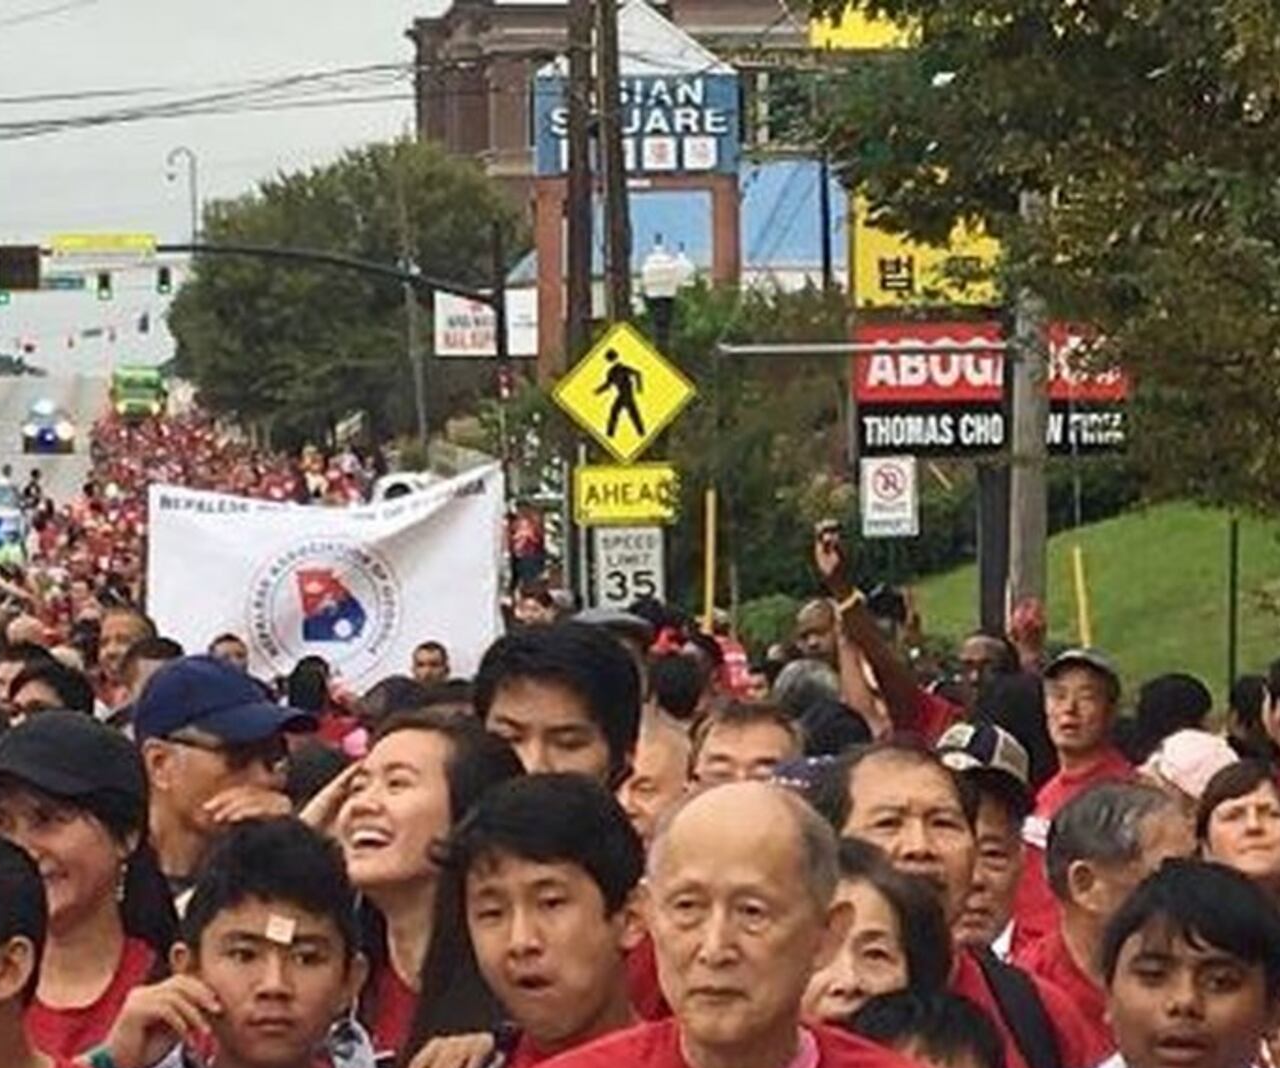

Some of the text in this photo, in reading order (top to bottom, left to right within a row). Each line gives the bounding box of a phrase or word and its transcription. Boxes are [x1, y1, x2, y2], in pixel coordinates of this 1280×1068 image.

[550, 108, 729, 135] SUARE
[862, 414, 955, 446] THOMAS
[959, 412, 1004, 445] CHO
[584, 481, 672, 508] AHEAD
[604, 569, 657, 602] 35
